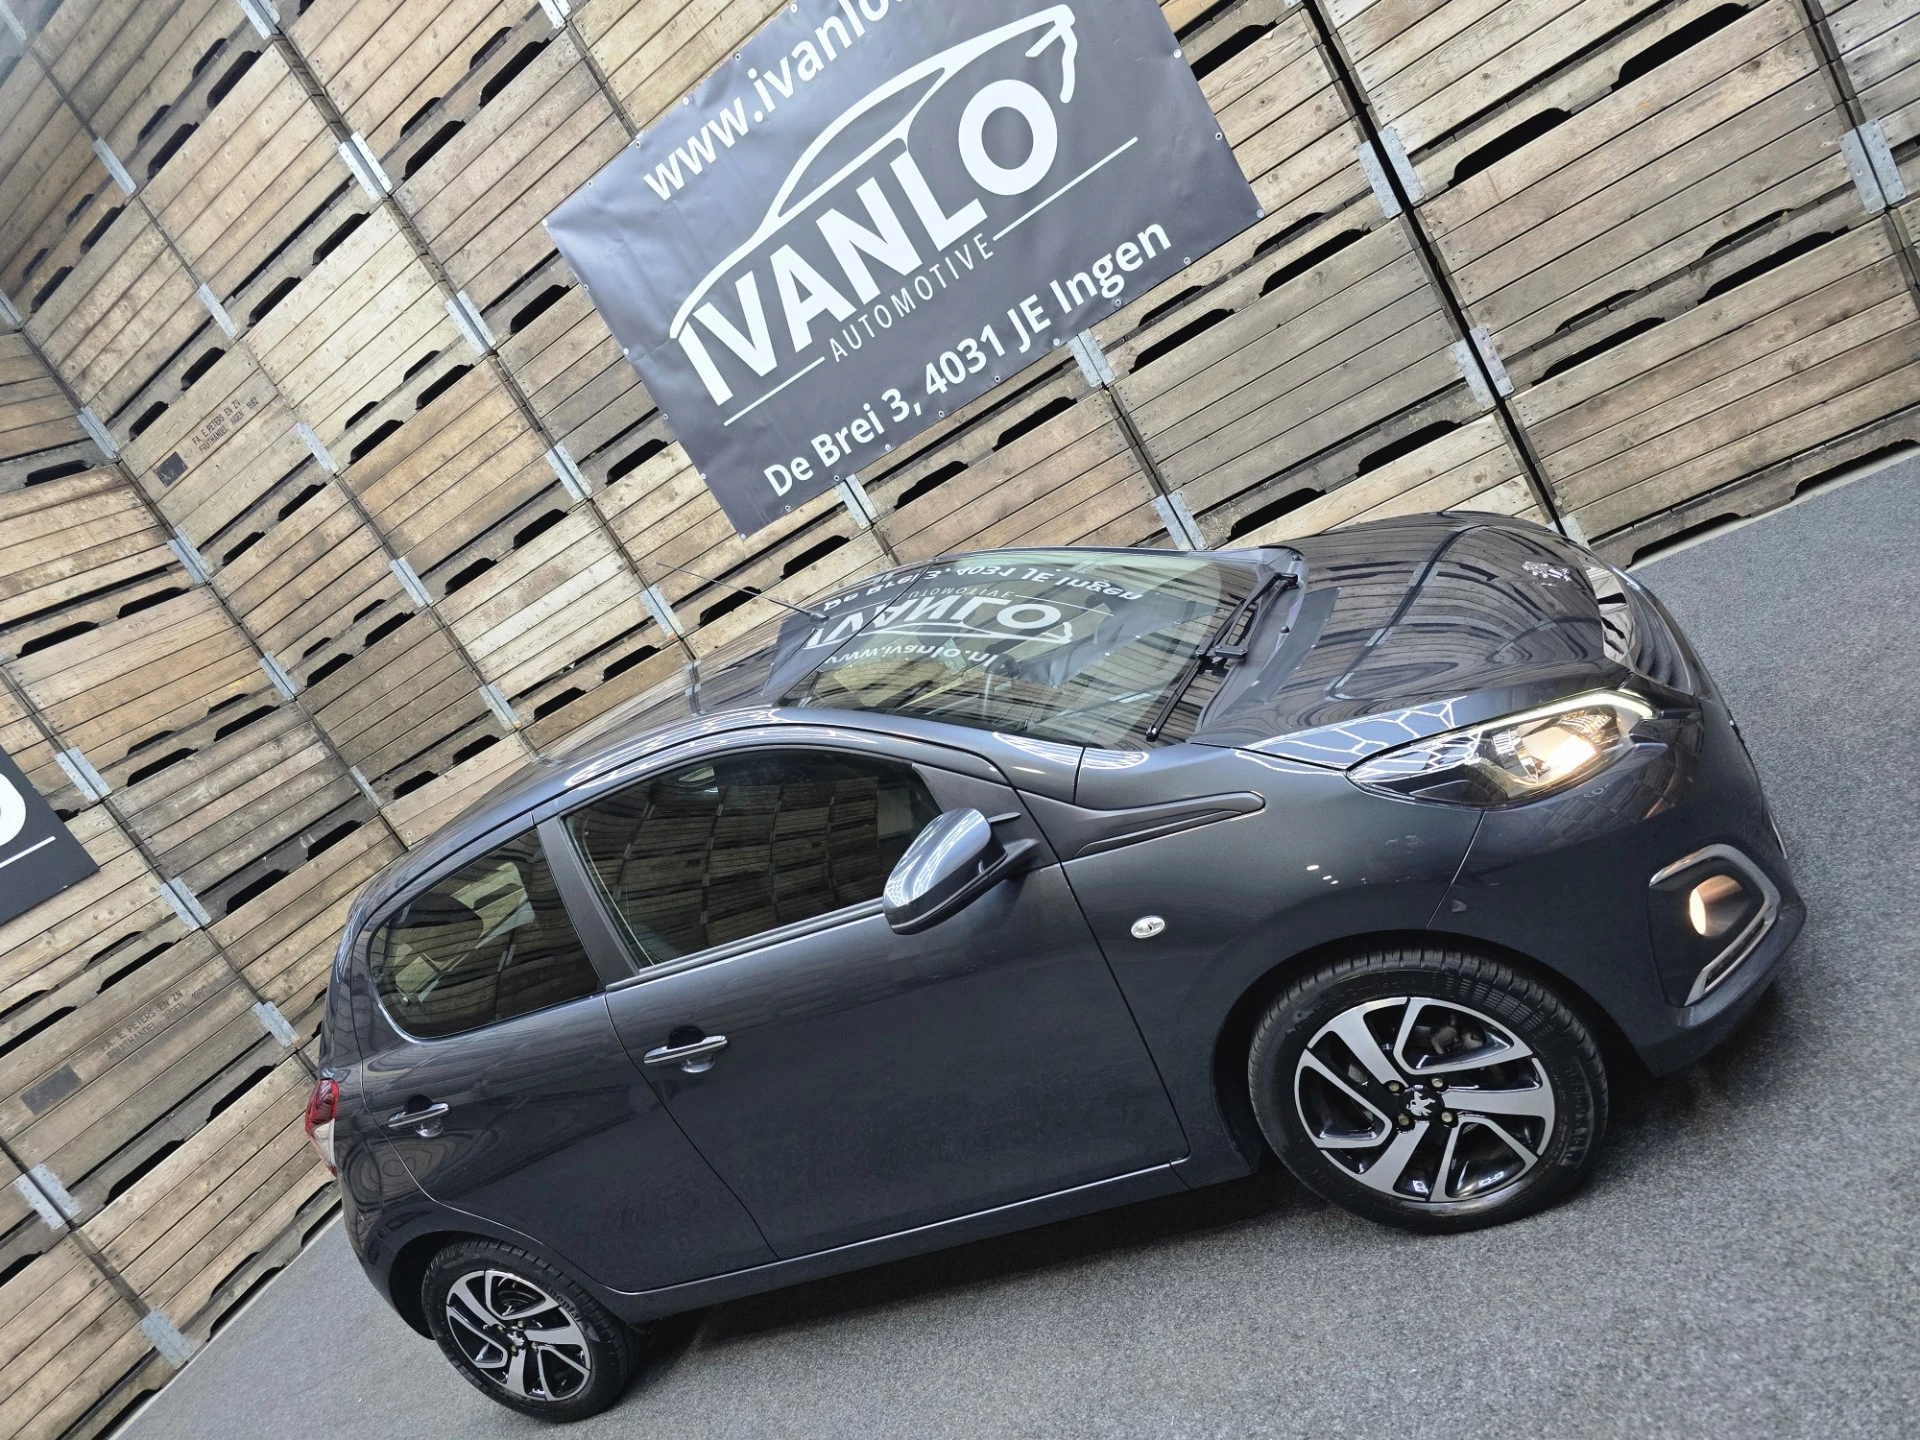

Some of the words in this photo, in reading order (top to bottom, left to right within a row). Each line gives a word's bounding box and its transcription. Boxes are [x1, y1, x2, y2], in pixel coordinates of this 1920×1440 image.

[643, 0, 903, 201] www.ivanlo
[678, 79, 1058, 406] IVANLO
[828, 232, 995, 363] AUTOMOTIVE
[206, 414, 225, 432] PETERS
[224, 408, 233, 416] EN
[763, 455, 814, 497] De
[811, 403, 885, 468] Brei
[880, 387, 922, 423] 3,
[925, 324, 1006, 398] 4031
[1007, 294, 1052, 354] JE
[1049, 222, 1172, 313] Ingen
[128, 1010, 156, 1032] PETERS
[157, 1000, 170, 1011] EN
[171, 990, 183, 1001] ZN
